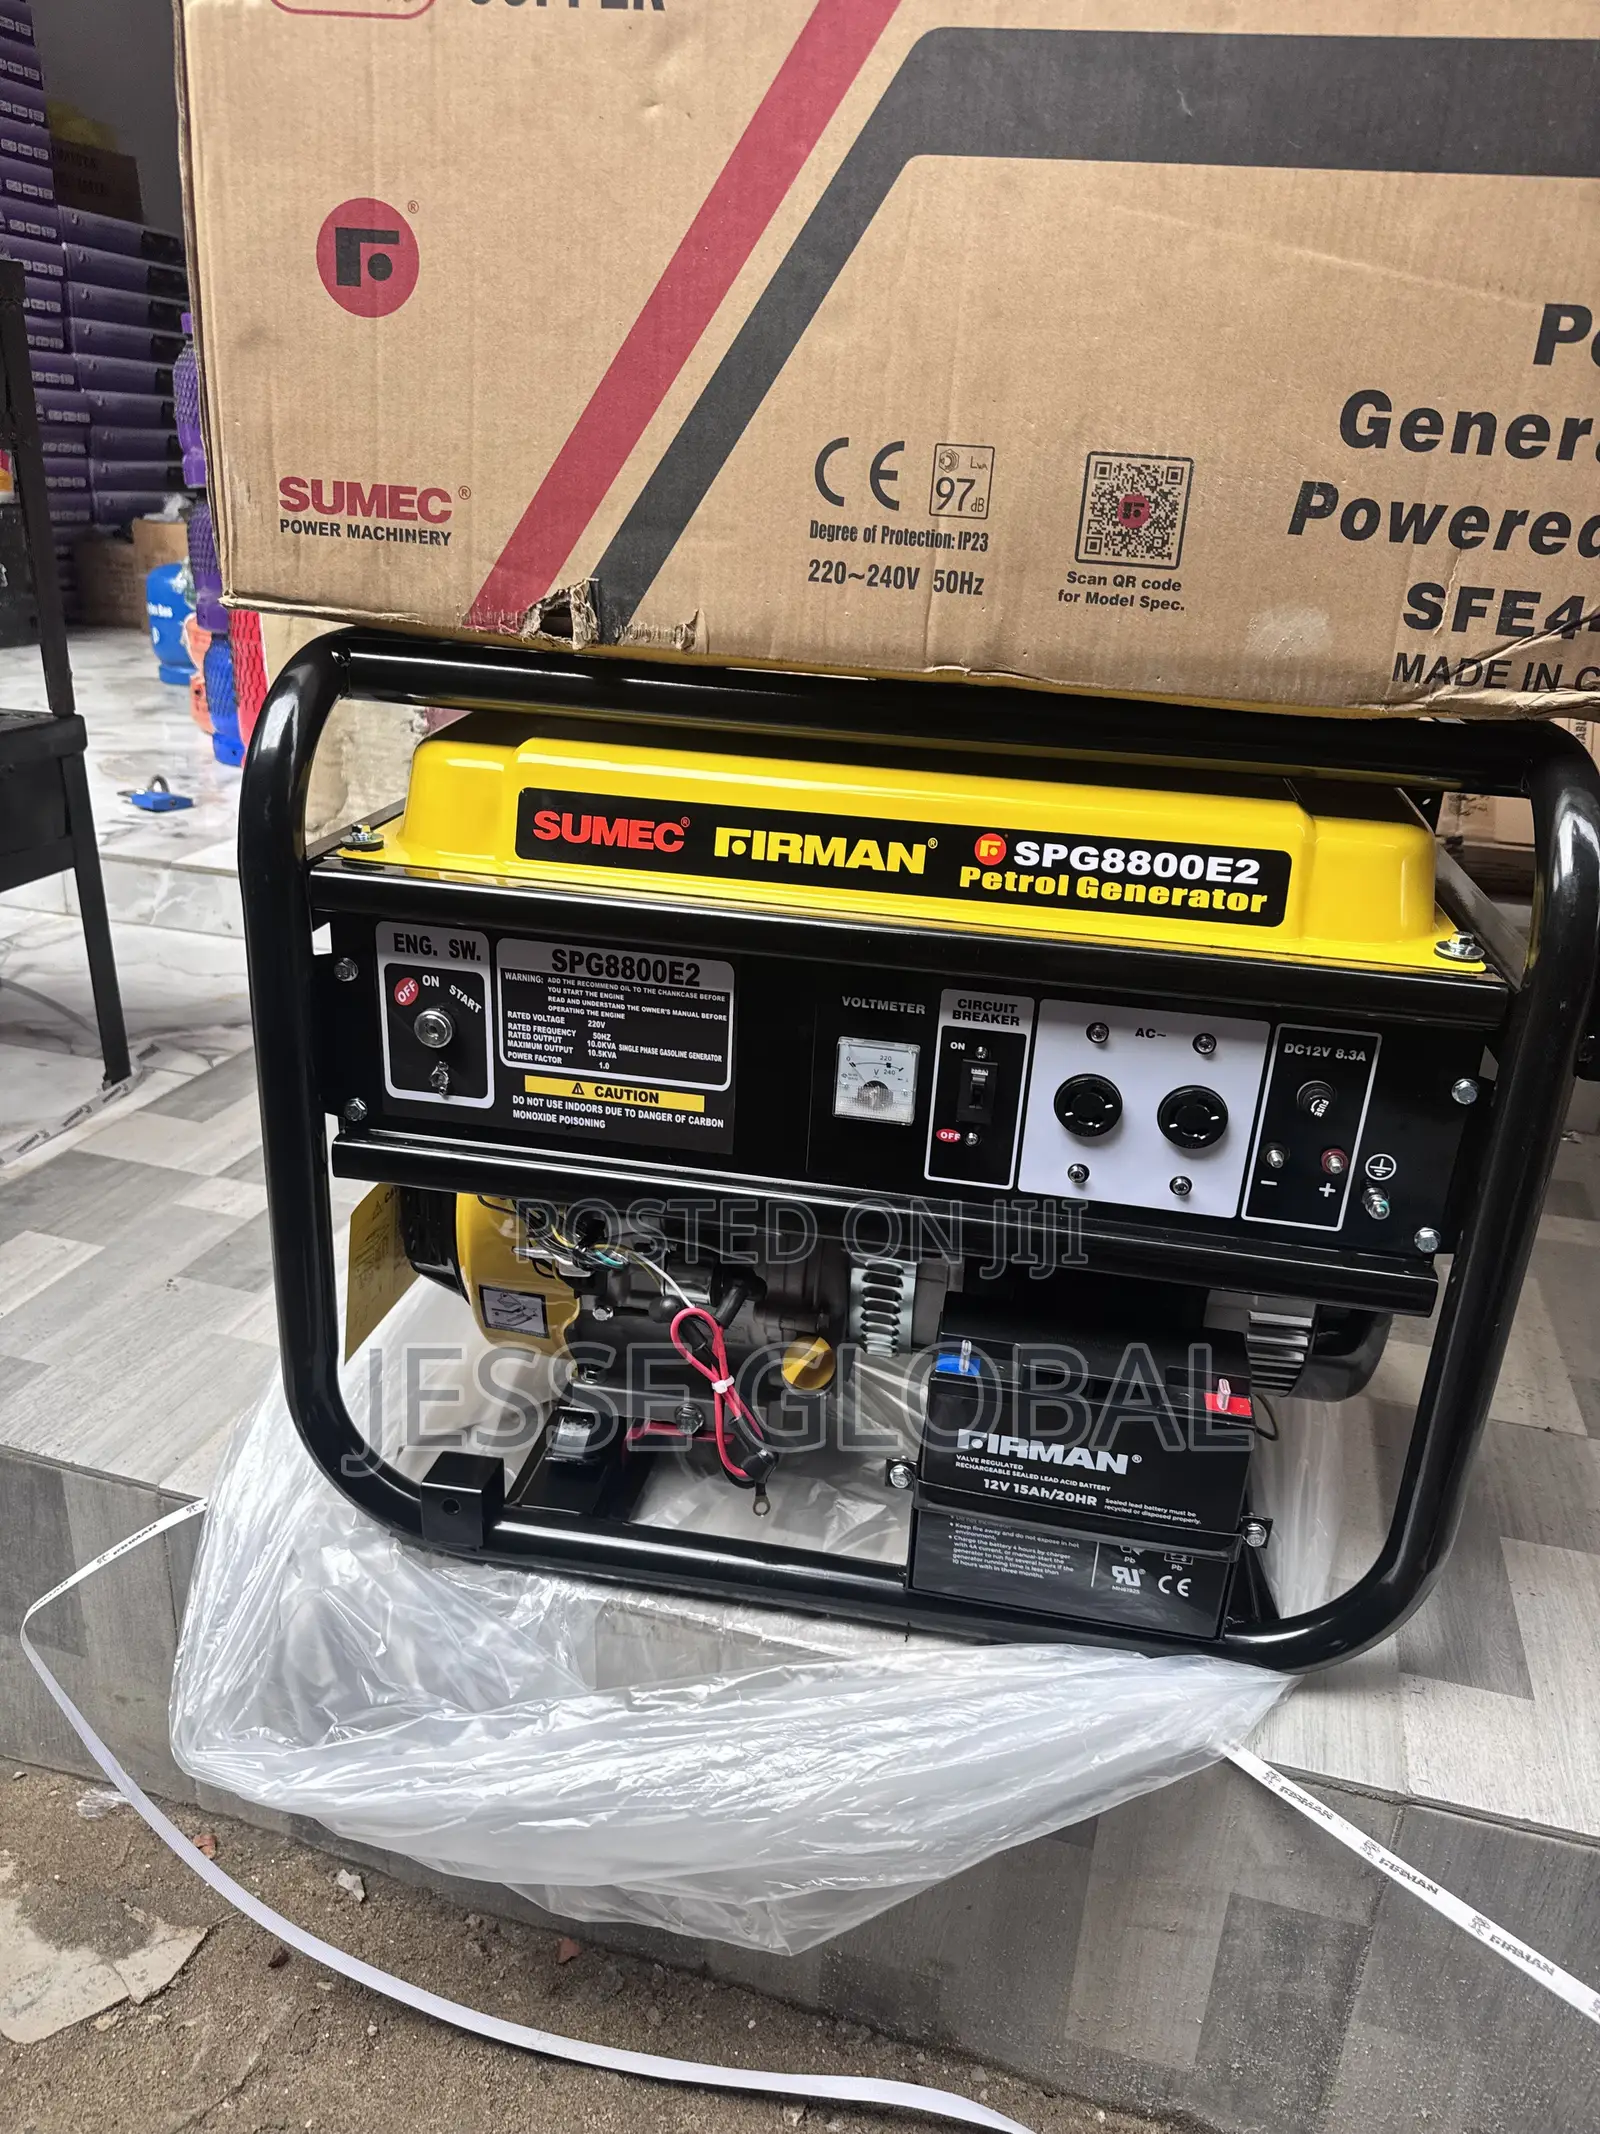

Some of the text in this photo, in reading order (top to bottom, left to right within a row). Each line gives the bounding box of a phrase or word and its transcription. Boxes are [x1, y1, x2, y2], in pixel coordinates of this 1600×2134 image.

[1533, 303, 1600, 369] P
[1340, 389, 1600, 463] Gener
[936, 476, 984, 513] 97 dB
[280, 518, 452, 546] POWER MACHINERY
[810, 520, 989, 552] Degree of Protection: IP23
[808, 559, 984, 595] 220~240V 50Hz
[1066, 571, 1182, 592] Scan QR code
[1058, 589, 1185, 611] for Model Spec.
[1402, 581, 1600, 640] SFE4
[1392, 652, 1512, 690] MADE
[1521, 662, 1563, 692] IN
[1014, 840, 1260, 885] SPG8800E2
[959, 866, 1268, 913] Petrol Generator
[393, 933, 481, 961] ENG. SW.
[551, 948, 701, 987] SPG8800E2
[398, 975, 482, 1014] OFF ON START
[505, 972, 543, 984] WARNING:
[577, 980, 619, 990] RECOMMEND
[658, 989, 698, 999] CHANKCASE
[700, 994, 726, 1002] BEFORE
[563, 988, 583, 996] START
[600, 992, 624, 1000] ENGINE
[548, 1005, 585, 1014] OPERATING
[601, 1011, 626, 1020] ENGINE
[582, 1000, 625, 1010] UNDERSTAND
[642, 1006, 671, 1015] OWNER'S
[672, 1010, 700, 1018] MANUAL
[701, 1013, 727, 1021] BEFORE
[841, 996, 926, 1015] VOLTMETER
[958, 998, 1018, 1014] CIRCUIT
[507, 1010, 606, 1029] RATED VOLTAGE 220V
[952, 1010, 1020, 1026] BREAKER
[508, 1023, 612, 1041] RATED FREQUENCY 50HZ
[507, 1040, 617, 1059] MAXIMUM OUTPUT 10.5KVA
[508, 1031, 722, 1062] RATED OUTPUT 10.0KVA SINGLE PHASE GASOLINE GENERATOR
[950, 1041, 965, 1050] ON
[1284, 1042, 1367, 1062] DC12V 8.3A
[508, 1051, 533, 1061] POWER
[535, 1054, 562, 1064] FACTOR
[594, 1086, 659, 1104] CAUTION
[512, 1095, 724, 1128] DO NOT USE INDOORS DUE TO DANGER OF CARBON
[1314, 1099, 1329, 1117] FUSE
[512, 1109, 606, 1129] MONOXIDE POISONING
[940, 1132, 960, 1141] OFF
[956, 1454, 1024, 1470] VALVE REGULATED
[955, 1462, 1111, 1492] RECHARGEABLE SEALED LEAD ACID BATTERY
[983, 1478, 1097, 1506] 12V 15Ah/20HR
[1104, 1504, 1132, 1514] recycled
[1142, 1510, 1171, 1520] disposed
[1172, 1516, 1201, 1525] properly.
[1105, 1498, 1127, 1506] Sealed
[1128, 1501, 1142, 1509] lead
[1144, 1504, 1168, 1514] battery
[1169, 1508, 1186, 1516] must
[978, 1538, 988, 1546] the
[989, 1540, 1012, 1551] battery
[1018, 1546, 1036, 1554] hours
[1002, 1529, 1014, 1538] and
[1037, 1536, 1060, 1545] expose
[1124, 1556, 1136, 1564] Pb
